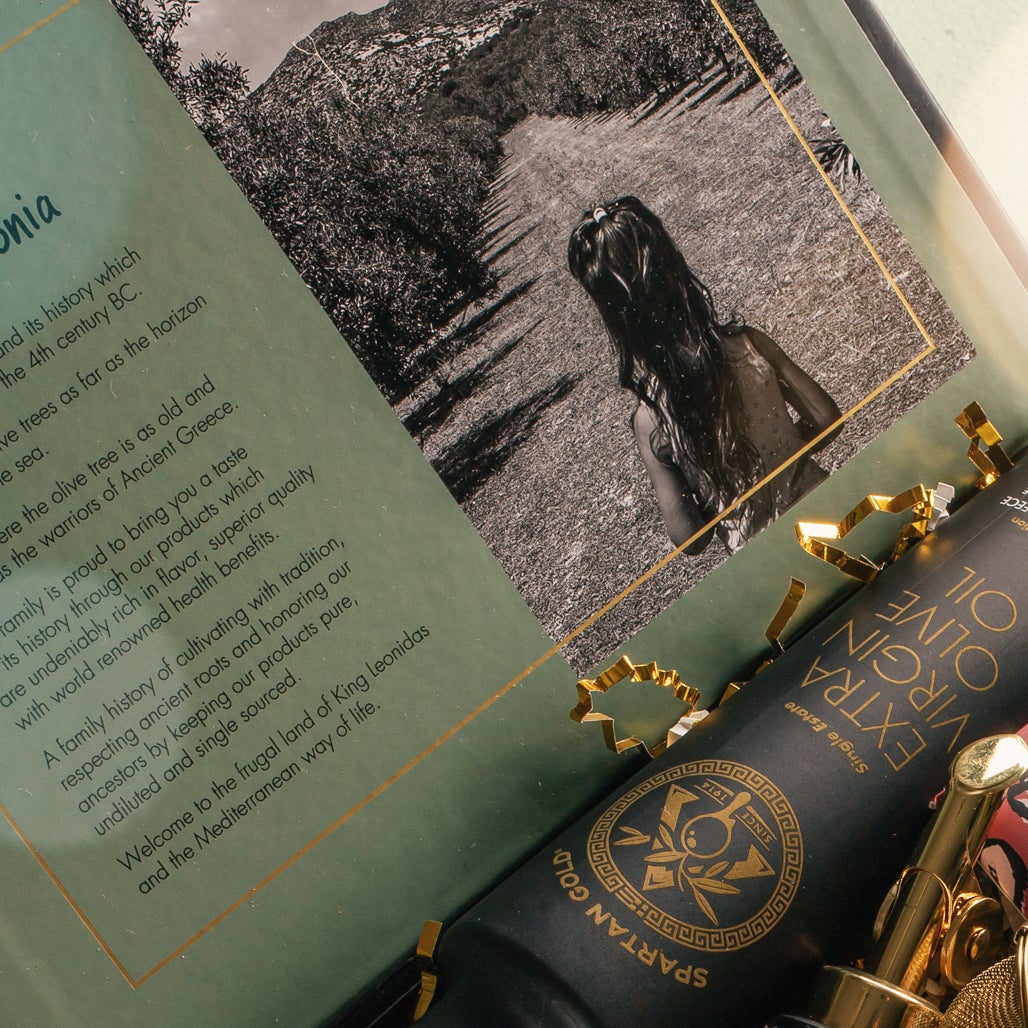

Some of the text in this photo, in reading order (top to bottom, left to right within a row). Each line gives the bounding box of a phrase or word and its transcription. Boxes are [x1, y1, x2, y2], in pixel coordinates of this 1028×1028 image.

[0, 464, 316, 708] are undeniably rich in flavor, superior quality
[1, 465, 265, 671] its history through our products which
[43, 586, 62, 602] is
[61, 543, 109, 595] proud
[106, 538, 126, 555] to
[122, 506, 170, 542] bring
[167, 483, 198, 516] you
[199, 473, 213, 488] a
[210, 447, 248, 478] taste
[945, 566, 1018, 633] OIL
[14, 531, 280, 731] with world renowned health benefits.
[42, 538, 345, 770] A family history of cultivating with tradition,
[60, 560, 352, 792] respecting ancient roots and honoring our
[78, 596, 359, 814] ancestors by keeping our products pure,
[822, 619, 970, 753] VIRGIN
[875, 590, 999, 692] OLIVE
[93, 667, 302, 836] undiluted and single sourced.
[115, 625, 430, 872] Welcome to the frugal land of King Leonidas
[701, 782, 728, 805] 1914
[784, 697, 869, 774] Single Estate
[801, 656, 927, 772] EXTRA
[138, 700, 381, 895] and the Mediterranean way of life.
[741, 809, 774, 844] SINCE
[553, 849, 709, 988] SPARTAN GOLD
